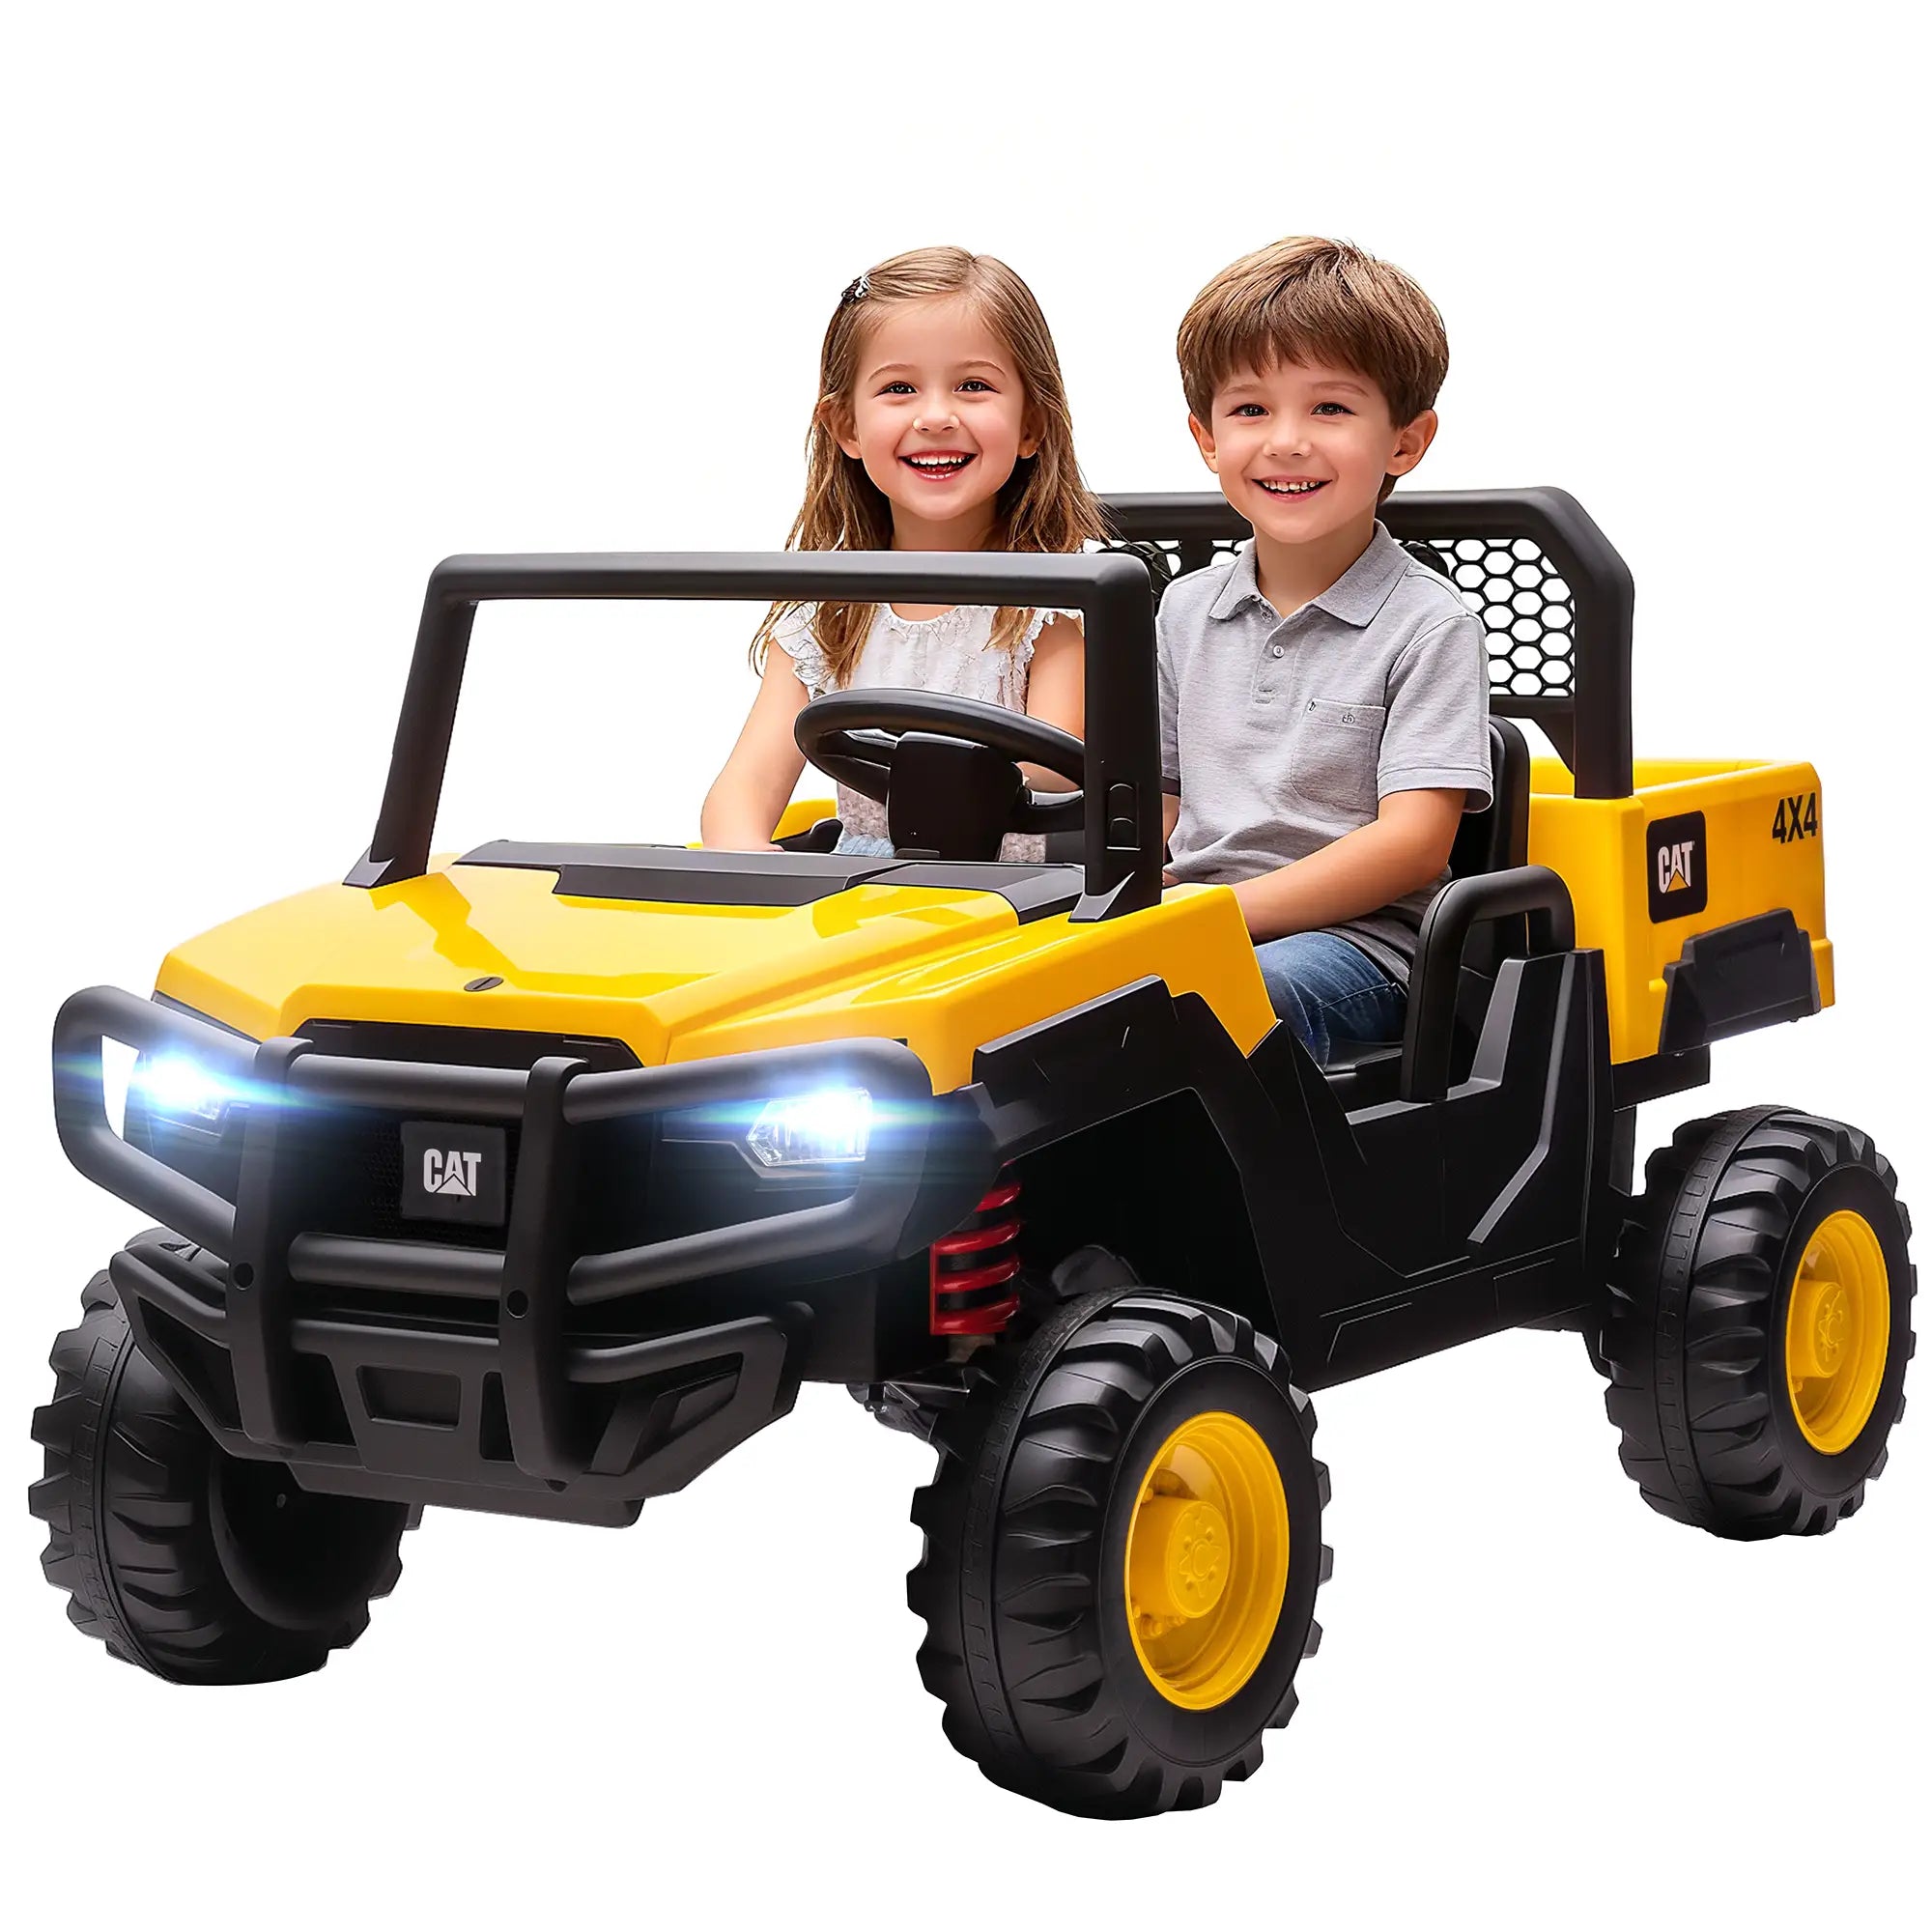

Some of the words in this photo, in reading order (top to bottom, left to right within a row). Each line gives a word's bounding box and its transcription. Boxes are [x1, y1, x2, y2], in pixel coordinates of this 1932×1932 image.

[1772, 792, 1818, 844] 4X4
[1658, 840, 1694, 894] CAT
[423, 1149, 482, 1197] CAT
